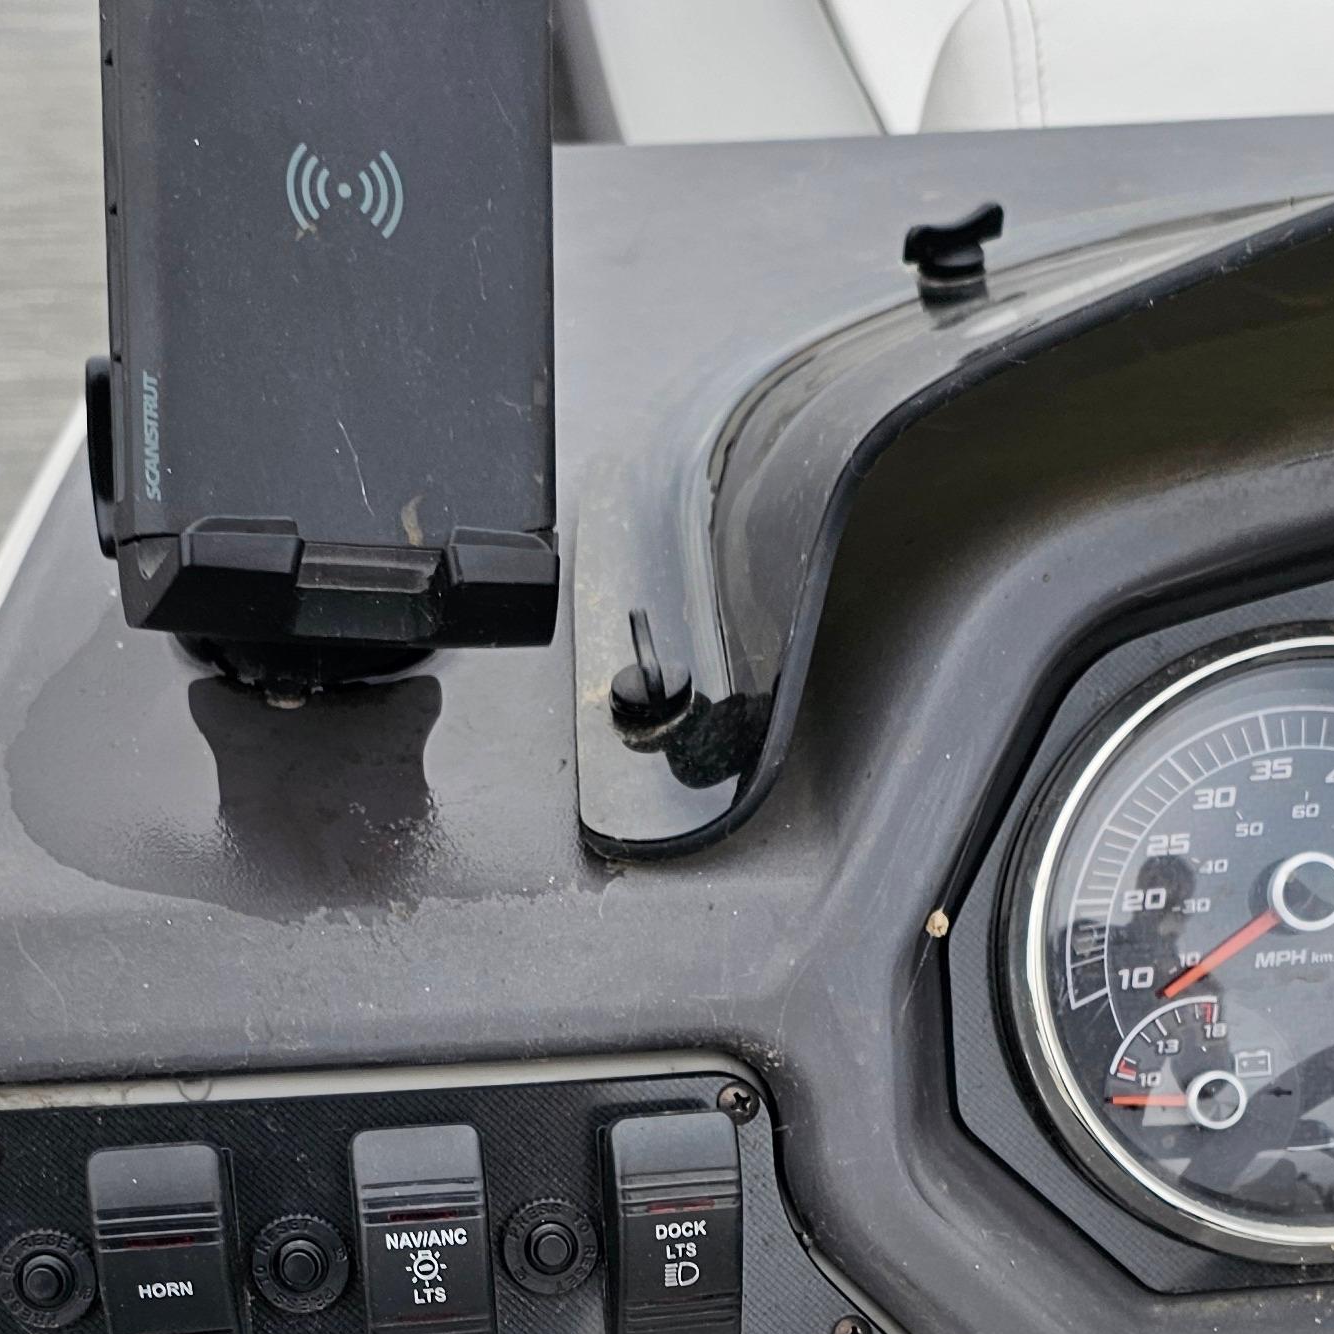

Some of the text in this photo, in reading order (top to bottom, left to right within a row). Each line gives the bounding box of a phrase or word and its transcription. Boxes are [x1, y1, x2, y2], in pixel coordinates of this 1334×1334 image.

[143, 370, 161, 502] SCANSTRUT
[1249, 757, 1293, 782] 35
[1193, 786, 1237, 810] 30
[1292, 803, 1320, 819] 60
[1235, 822, 1264, 837] 50
[1146, 833, 1191, 856] 25
[1199, 859, 1228, 875] 40
[1122, 888, 1166, 912] 20
[1183, 899, 1211, 914] 30
[1178, 951, 1202, 969] 10
[1255, 950, 1306, 969] MPH
[1119, 966, 1155, 990] 10
[1157, 1039, 1179, 1054] 13
[1139, 1072, 1161, 1087] 10
[655, 1219, 707, 1240] DOCK
[666, 1242, 697, 1260] LTS
[138, 1280, 194, 1299] HORN
[413, 1286, 447, 1304] LTS
